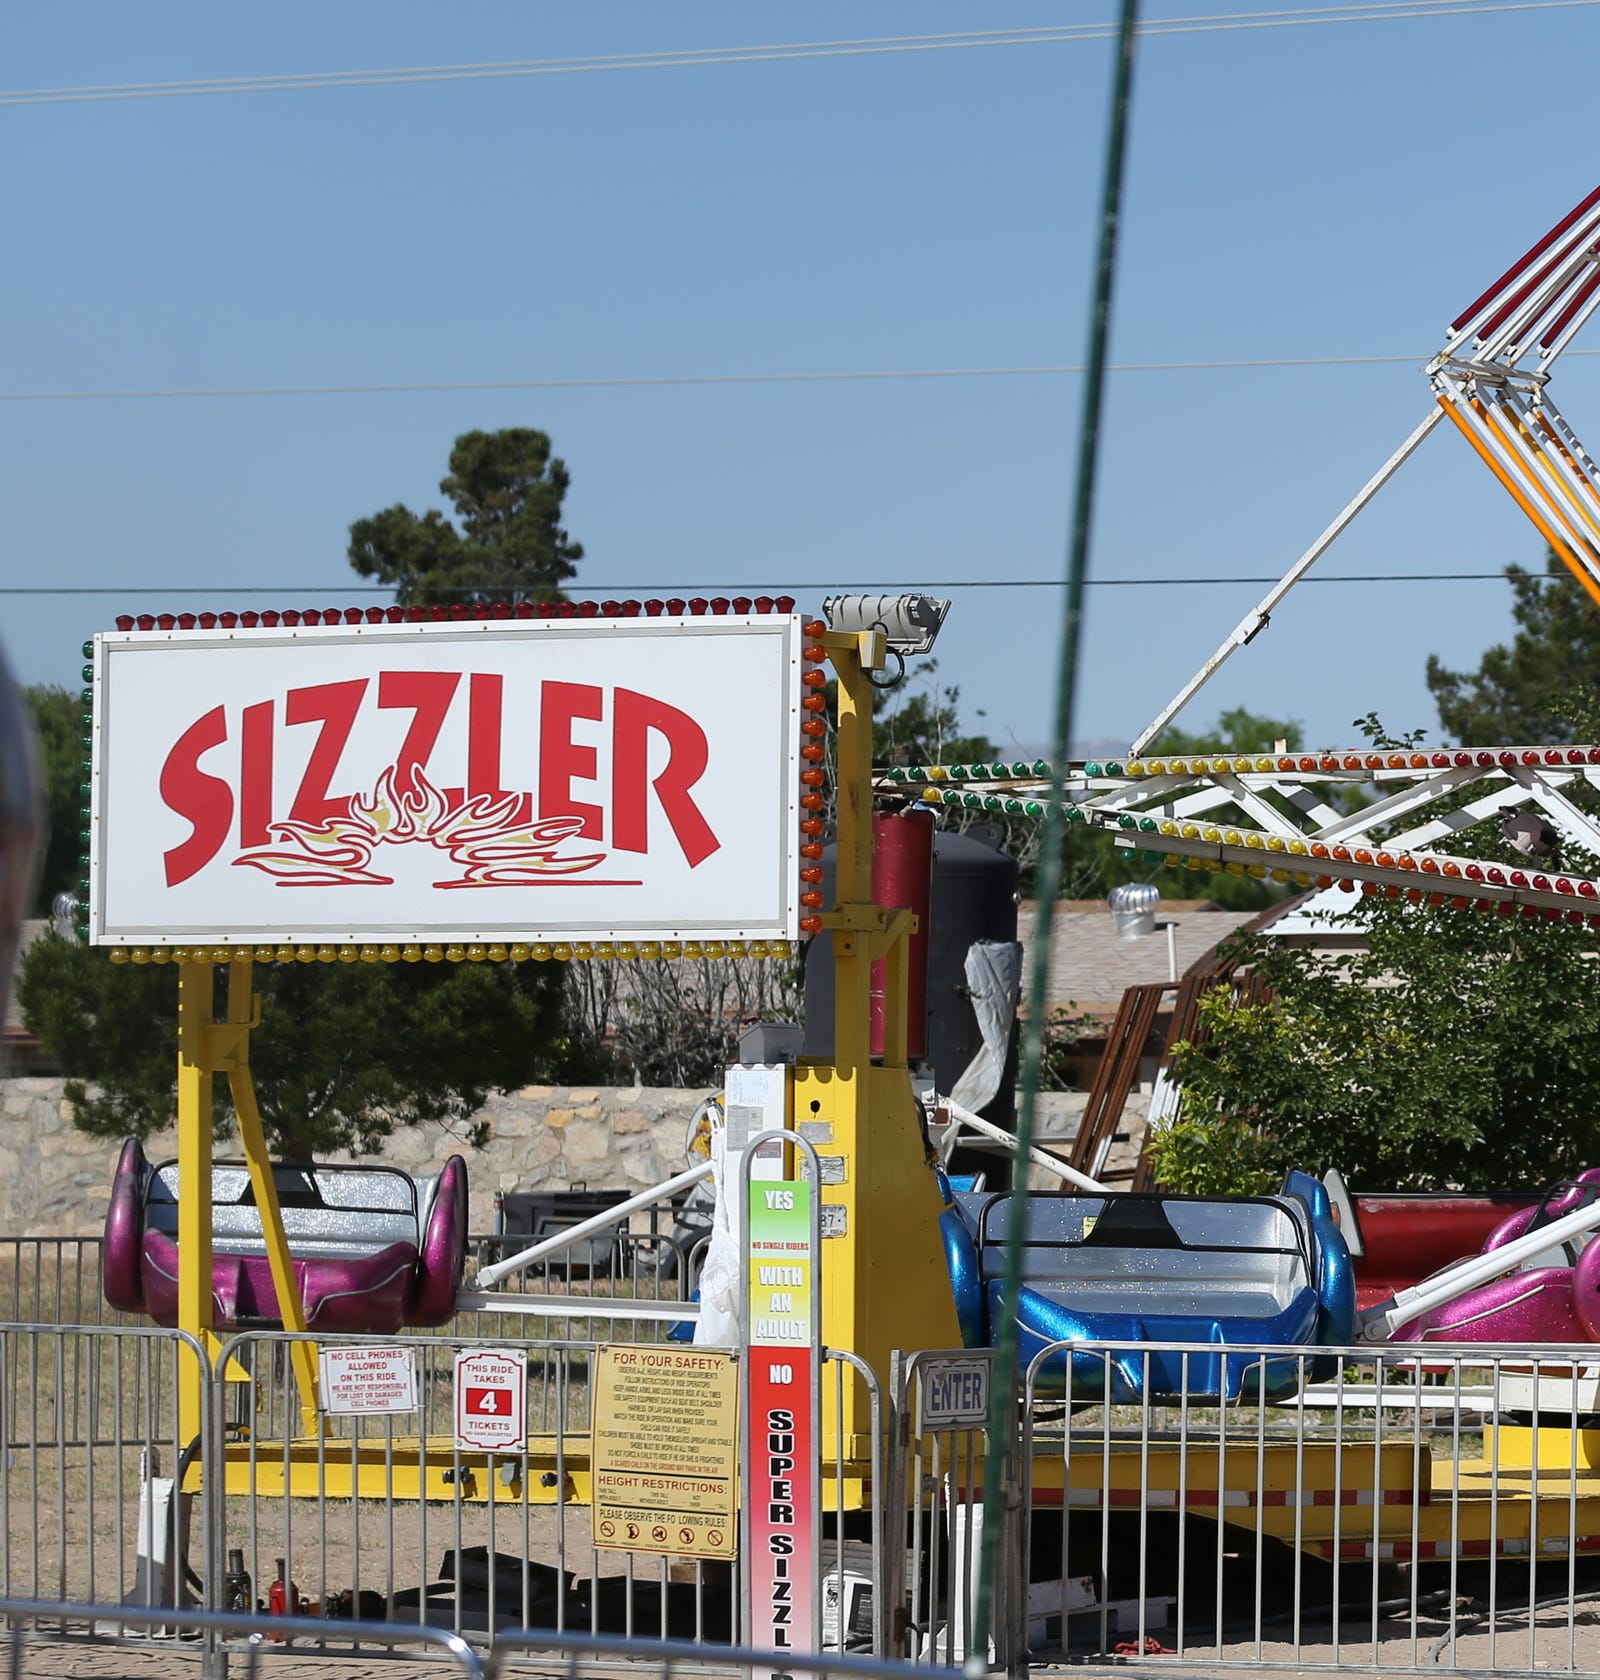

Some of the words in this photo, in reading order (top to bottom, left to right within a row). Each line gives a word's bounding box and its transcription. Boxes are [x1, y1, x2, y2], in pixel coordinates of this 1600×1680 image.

[158, 671, 721, 888] SIZZLER
[765, 1191, 793, 1210] YES
[786, 1242, 809, 1250] RIDERS
[759, 1267, 803, 1286] WITH
[770, 1293, 792, 1312] AN
[756, 1320, 805, 1339] ADULT
[346, 1352, 365, 1360] CELL
[368, 1350, 403, 1359] PHONES
[614, 1353, 636, 1364] FOR
[642, 1355, 671, 1367] YOUR
[676, 1358, 724, 1371] SAFETY:
[348, 1362, 387, 1370] ALLOWED
[466, 1364, 488, 1372] THIS
[490, 1366, 514, 1374] RIDE
[769, 1365, 793, 1384] NO
[340, 1374, 352, 1382] ON
[376, 1372, 396, 1380] RIDE
[474, 1375, 505, 1384] TAKES
[932, 1373, 982, 1410] ENTER
[479, 1391, 497, 1413] 4
[469, 1422, 510, 1430] TICKETS
[769, 1411, 793, 1522] SUPER
[599, 1476, 639, 1486] HEIGHT
[643, 1479, 727, 1493] RESTRICTIONS:
[600, 1510, 622, 1519] PLEASE
[624, 1512, 652, 1521] OBSERVE
[654, 1514, 665, 1522] THE
[667, 1515, 703, 1525] FOLOWING
[770, 1535, 793, 1680] SIZZL
